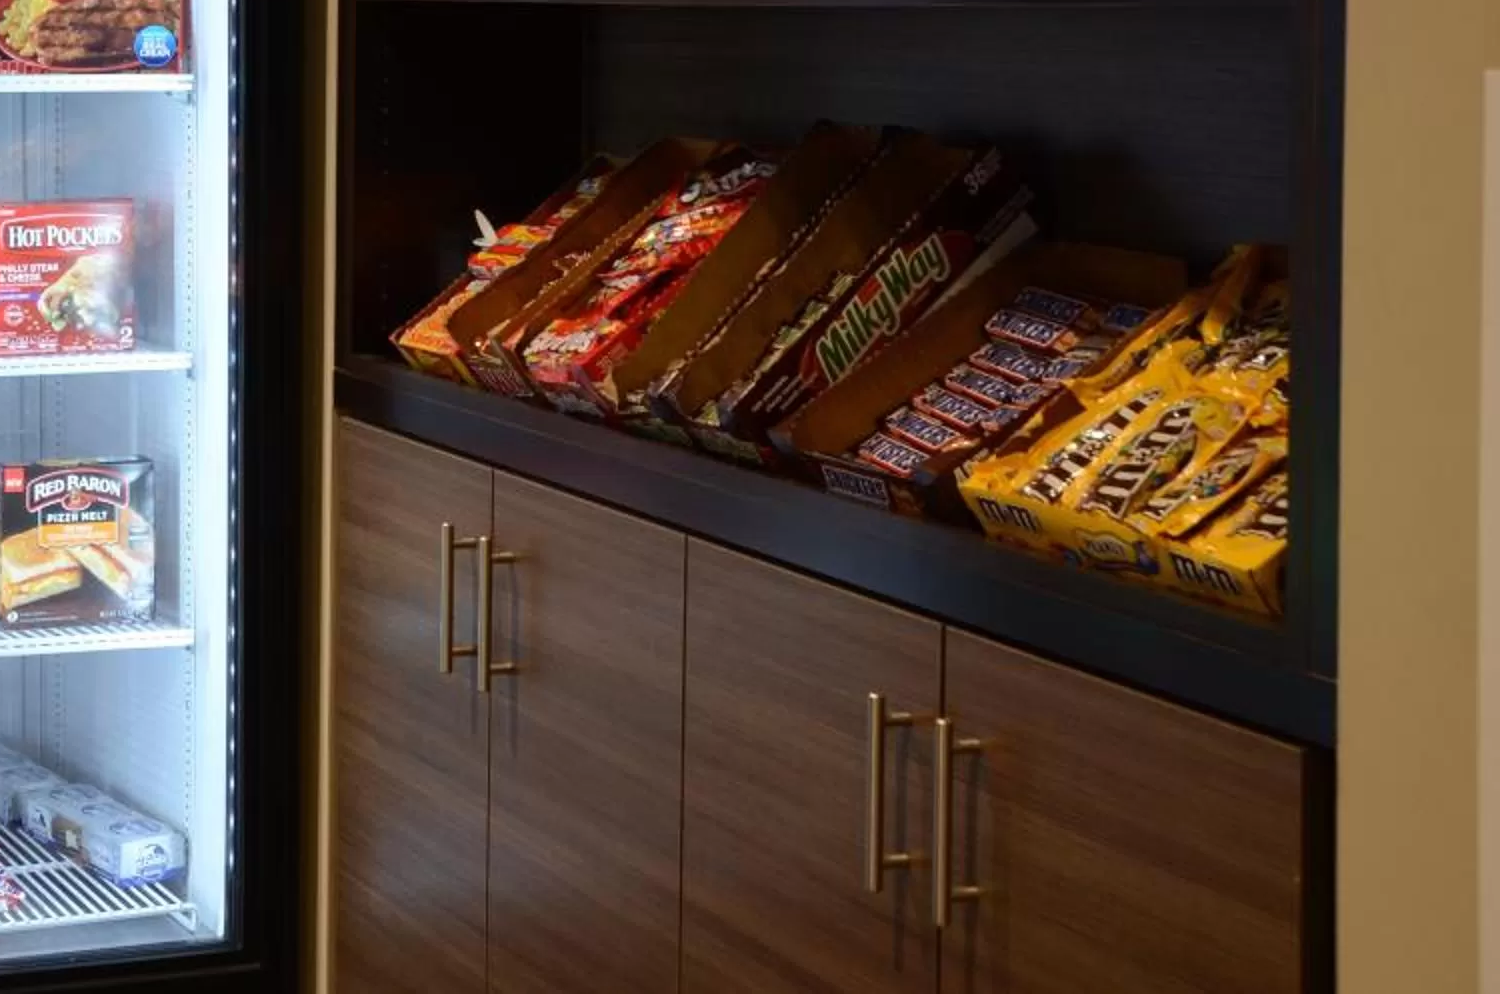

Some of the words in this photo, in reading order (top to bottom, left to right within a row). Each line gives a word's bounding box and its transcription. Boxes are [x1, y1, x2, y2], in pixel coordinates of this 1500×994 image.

[8, 225, 45, 248] HOT
[47, 220, 123, 247] POCKETS
[120, 326, 133, 343] 2
[34, 481, 65, 500] RED
[67, 475, 122, 497] BARON
